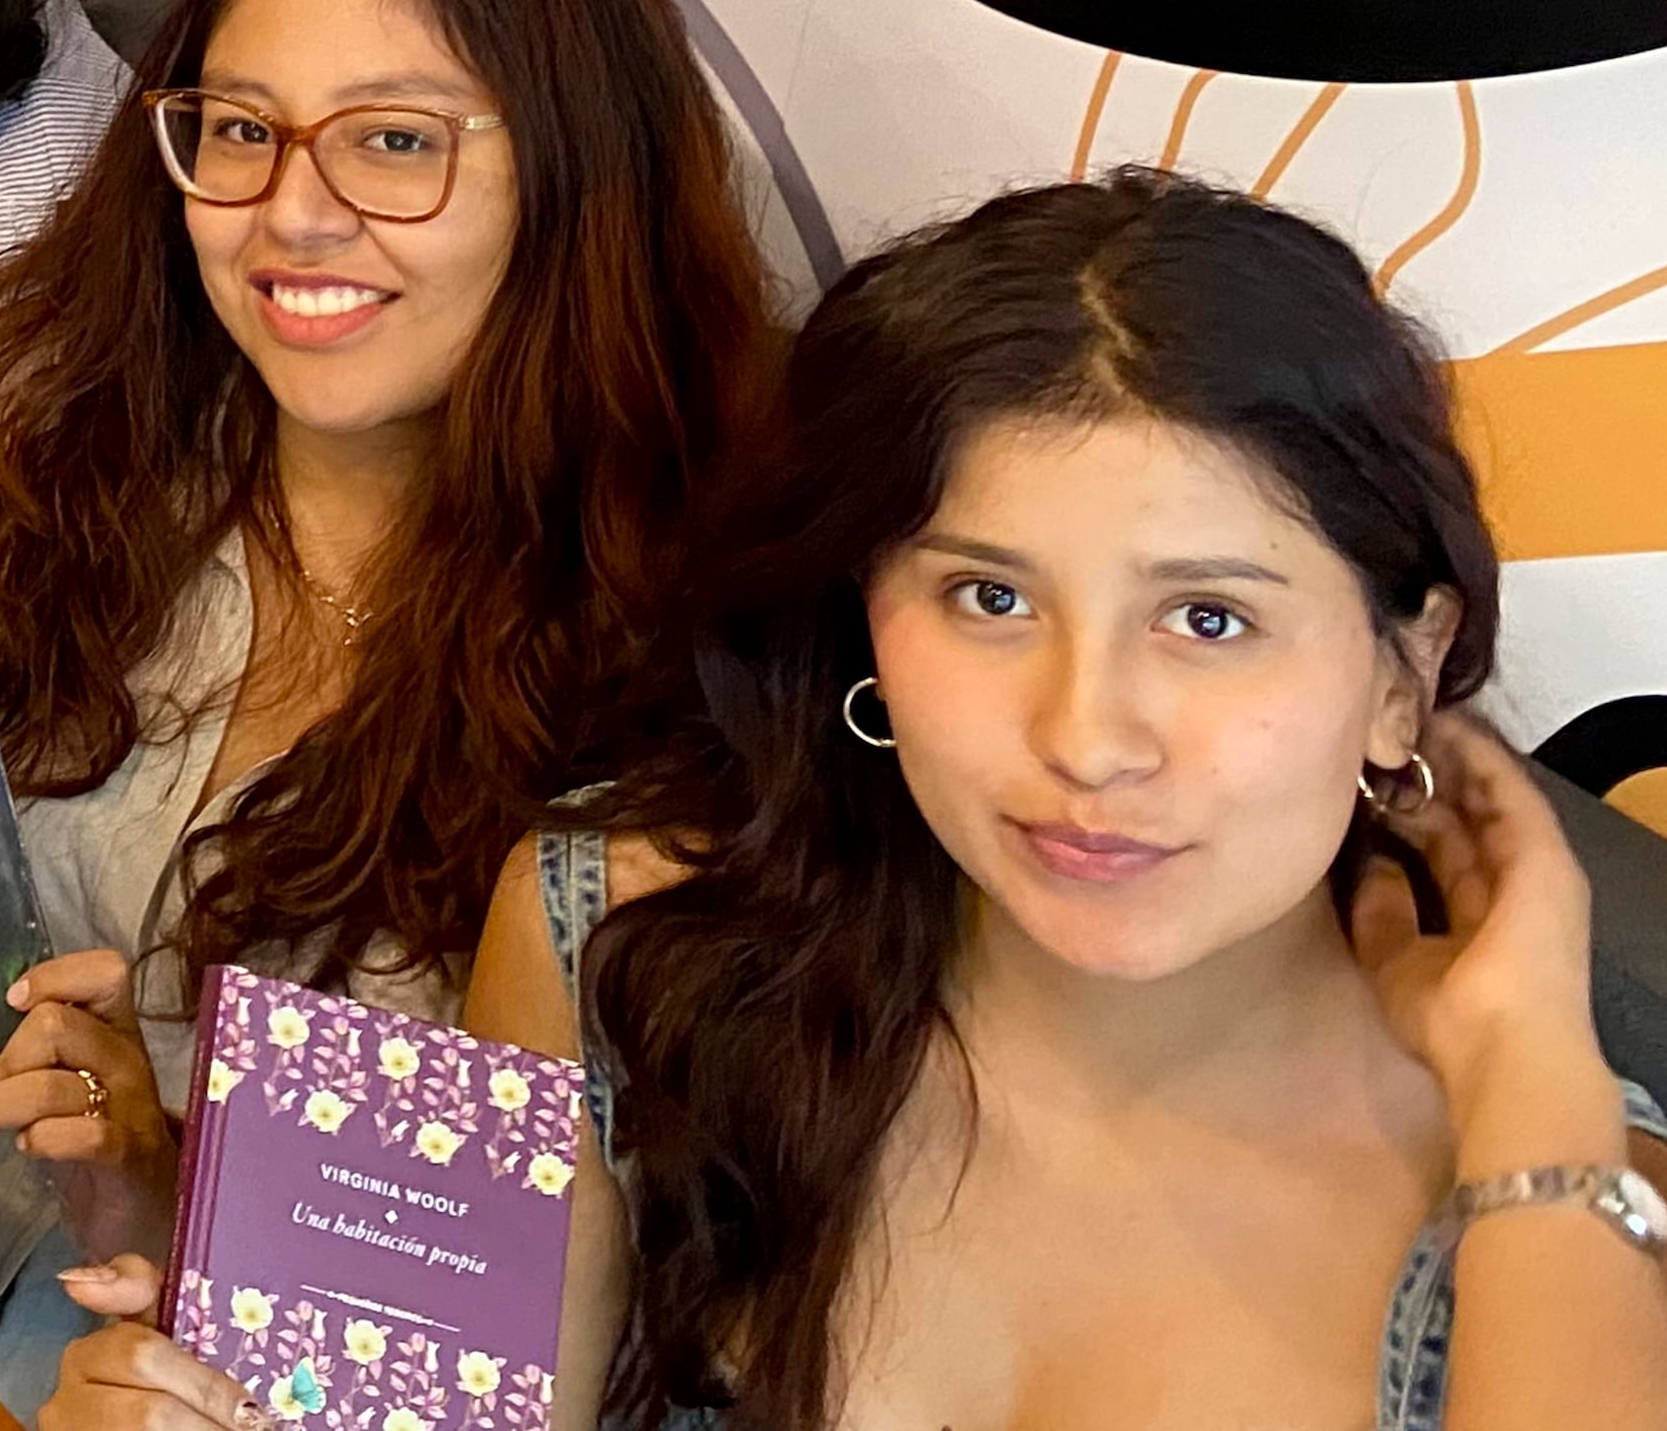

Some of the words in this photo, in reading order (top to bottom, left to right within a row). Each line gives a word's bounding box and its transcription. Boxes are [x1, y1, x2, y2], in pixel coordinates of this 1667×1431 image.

[320, 1163, 401, 1200] VIRGINIA
[405, 1187, 470, 1218] WOOLF
[292, 1202, 330, 1231] Una
[332, 1213, 427, 1258] habitación
[426, 1246, 487, 1275] propia
